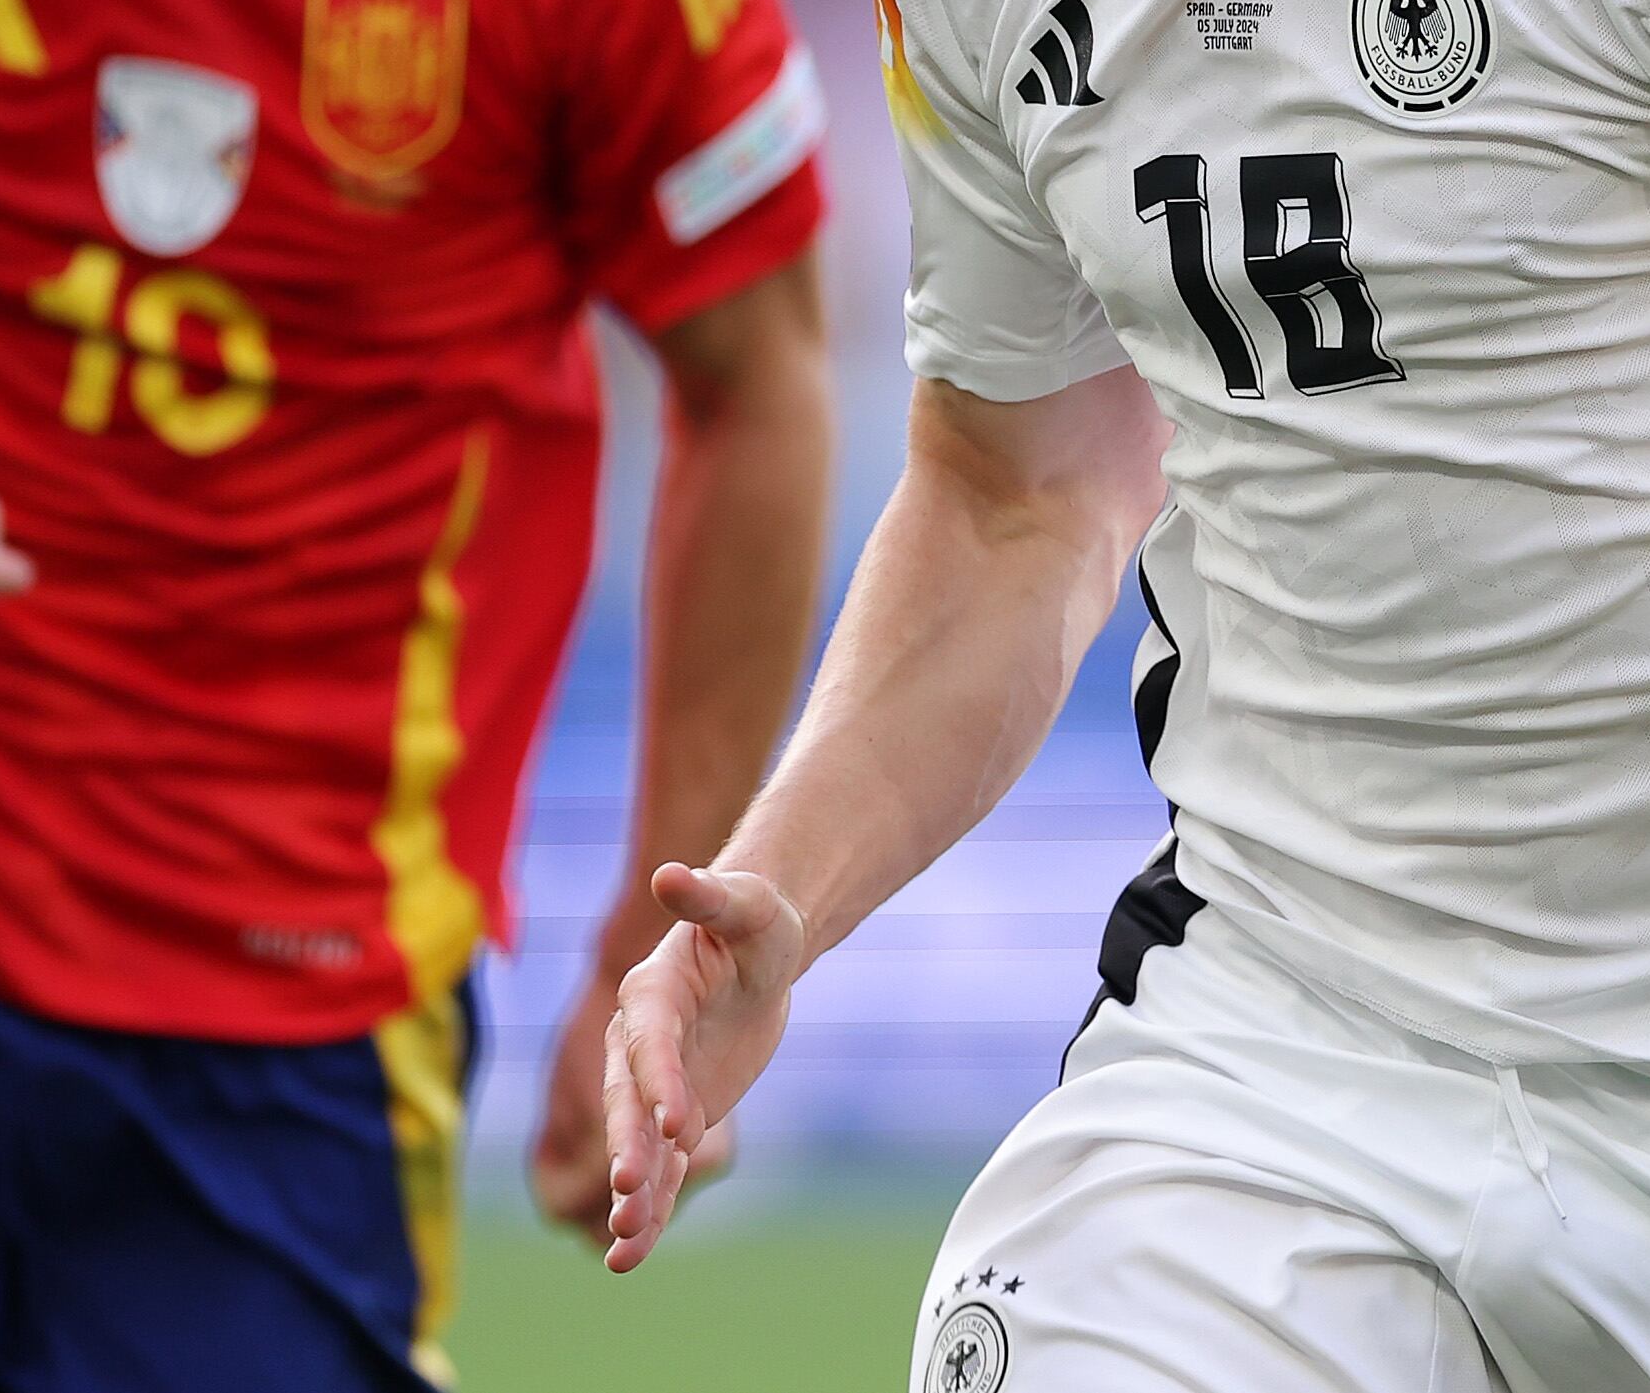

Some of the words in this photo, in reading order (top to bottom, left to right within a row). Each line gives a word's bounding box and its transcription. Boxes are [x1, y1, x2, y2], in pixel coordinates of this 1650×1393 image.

[1186, 2, 1215, 16] SPAIN
[1226, 2, 1273, 17] GERMANY
[1197, 19, 1210, 33] 05
[1213, 19, 1234, 33] JULY
[1236, 19, 1258, 33] 2024
[1204, 36, 1253, 50] STUTTGART
[1371, 40, 1467, 89] FUSSBALL-BUND
[1133, 152, 1407, 400] 18
[29, 242, 276, 456] 10
